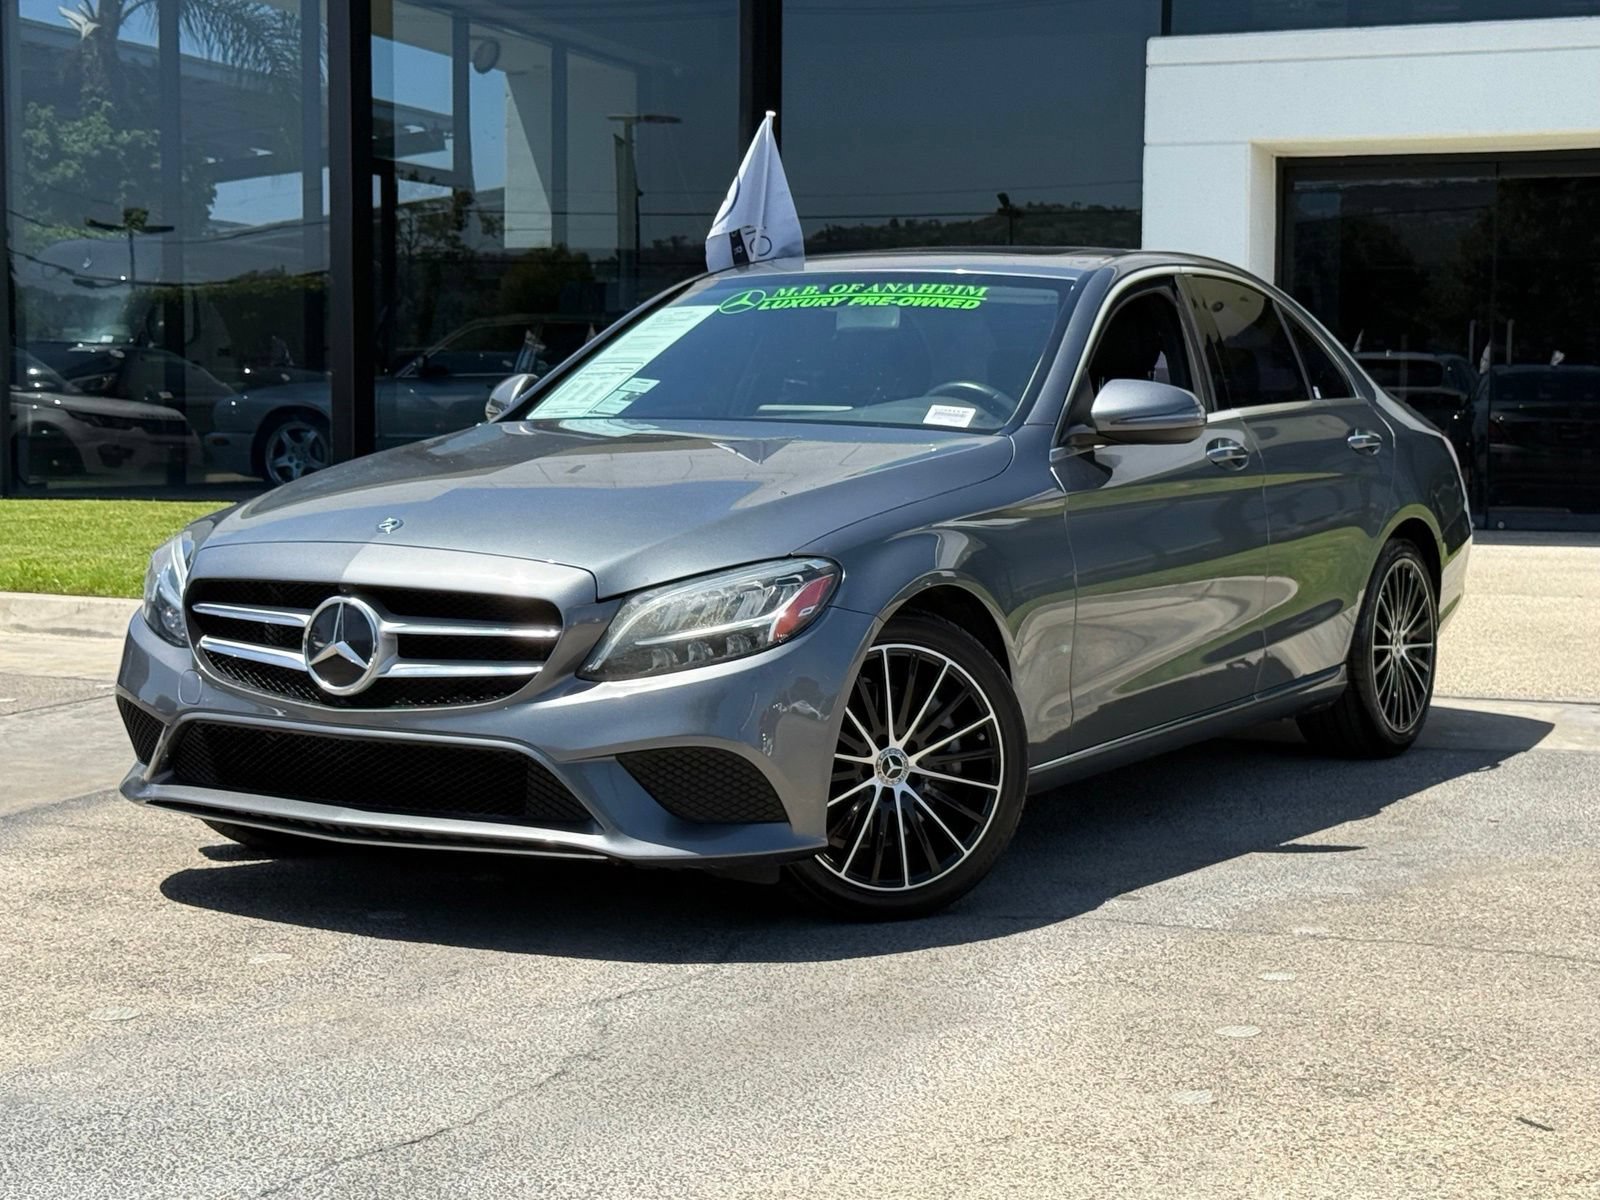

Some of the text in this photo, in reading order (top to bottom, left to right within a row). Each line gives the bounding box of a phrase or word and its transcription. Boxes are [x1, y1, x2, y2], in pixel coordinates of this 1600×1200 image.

[773, 282, 990, 297] M.B. OF ANAHEIM
[757, 296, 981, 311] LUXURY PRE-OWNED
